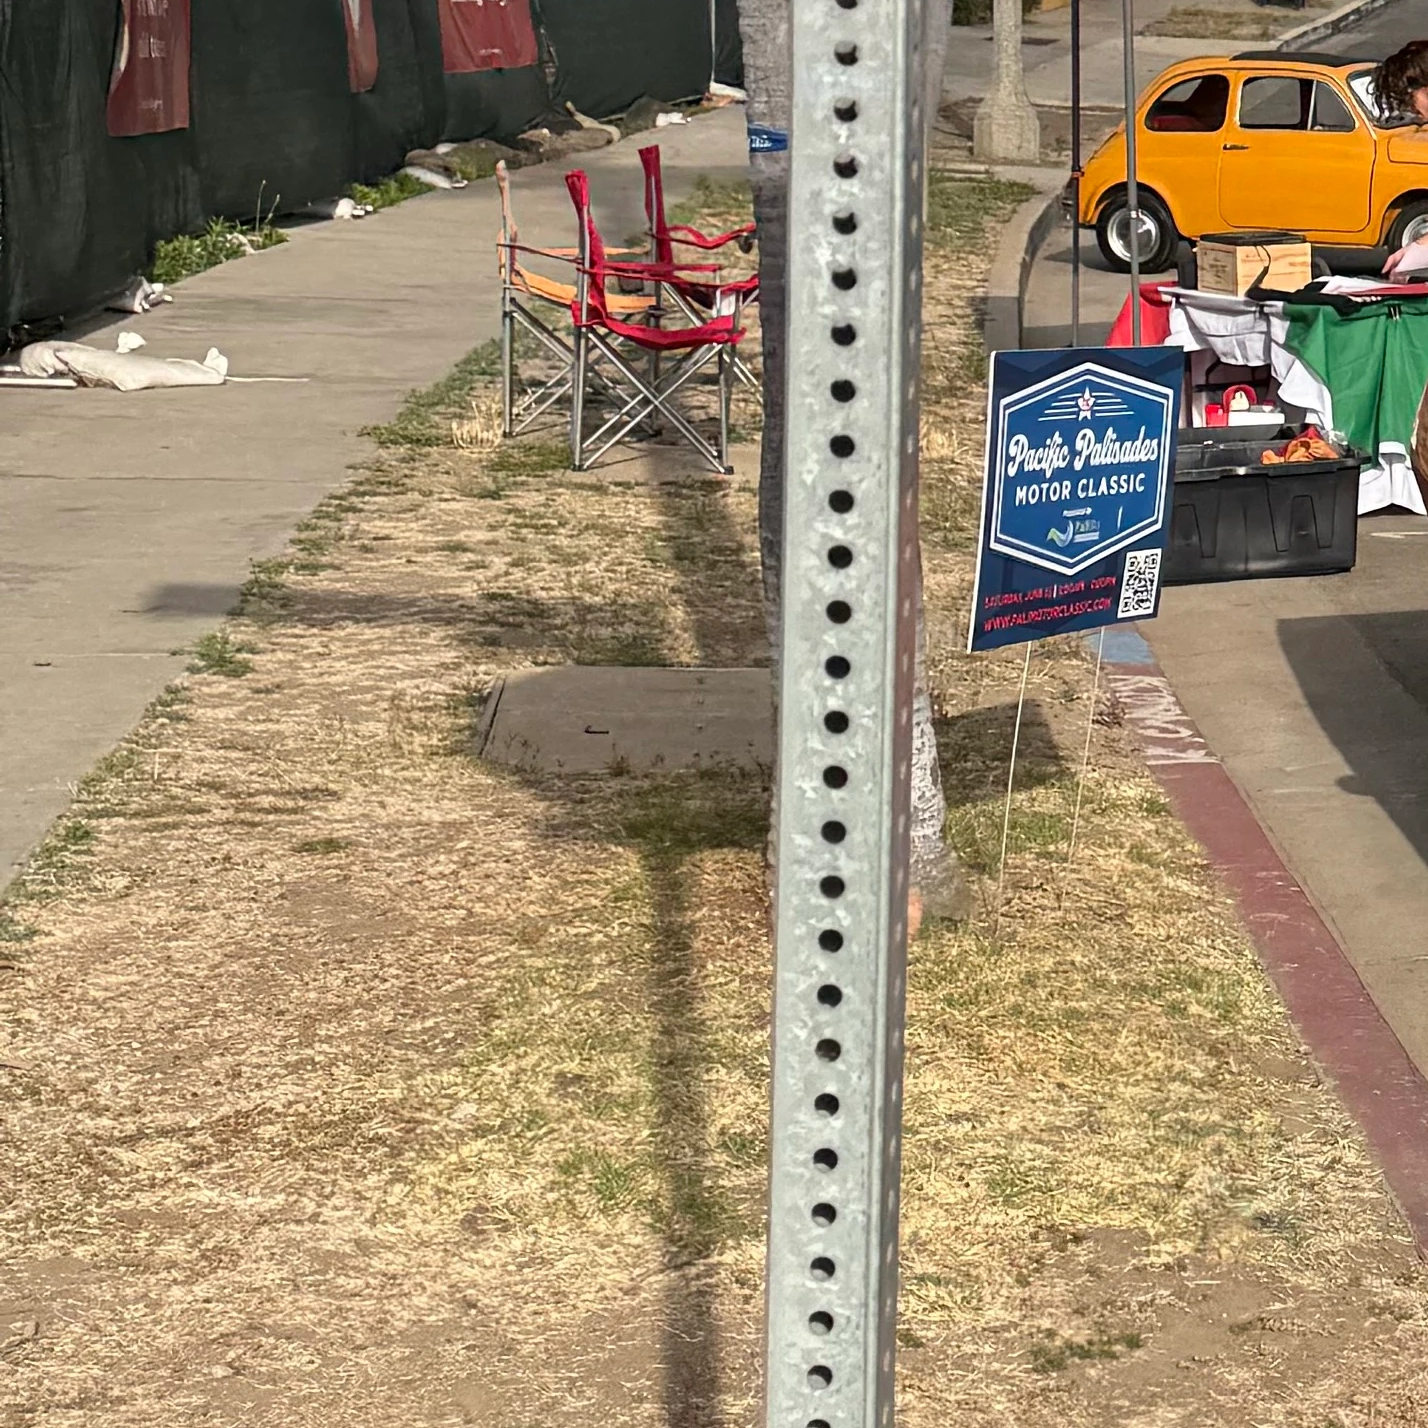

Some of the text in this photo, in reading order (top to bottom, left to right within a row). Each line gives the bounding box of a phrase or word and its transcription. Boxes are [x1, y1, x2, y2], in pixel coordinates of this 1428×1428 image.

[1007, 425, 1159, 478] Pacific Palisades
[1015, 473, 1146, 506] MOTOR CLASSIC
